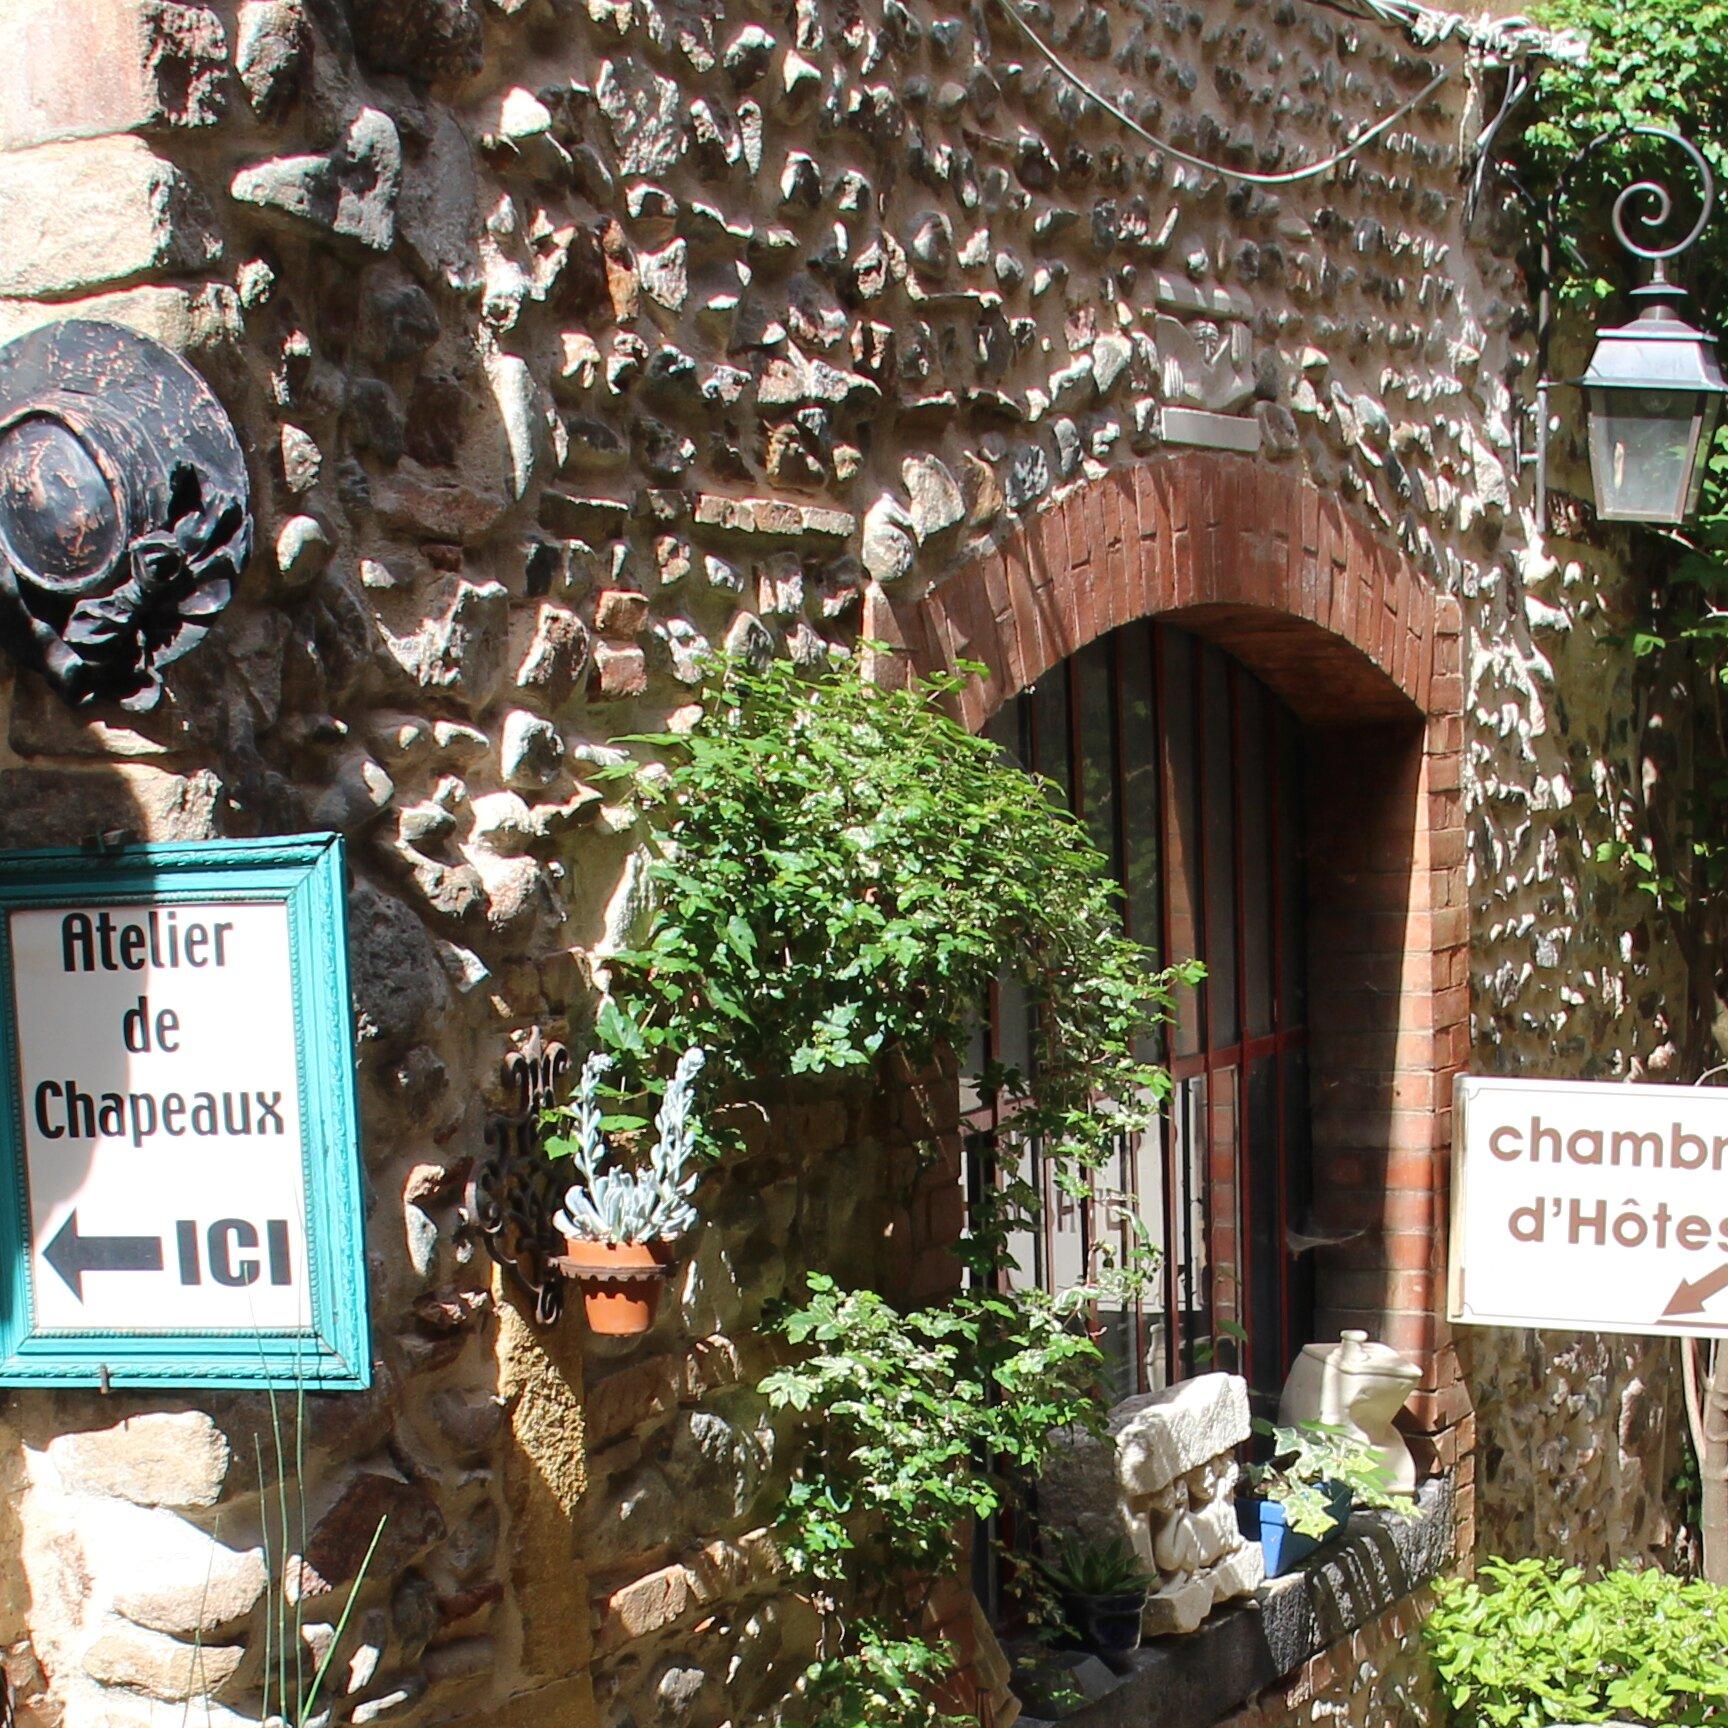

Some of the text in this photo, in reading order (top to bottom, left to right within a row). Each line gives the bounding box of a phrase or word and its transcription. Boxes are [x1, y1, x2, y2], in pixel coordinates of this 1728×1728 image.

[62, 911, 233, 972] Atelier
[123, 996, 179, 1053] de
[35, 1080, 284, 1147] Chapeaux
[175, 1218, 292, 1288] ICI
